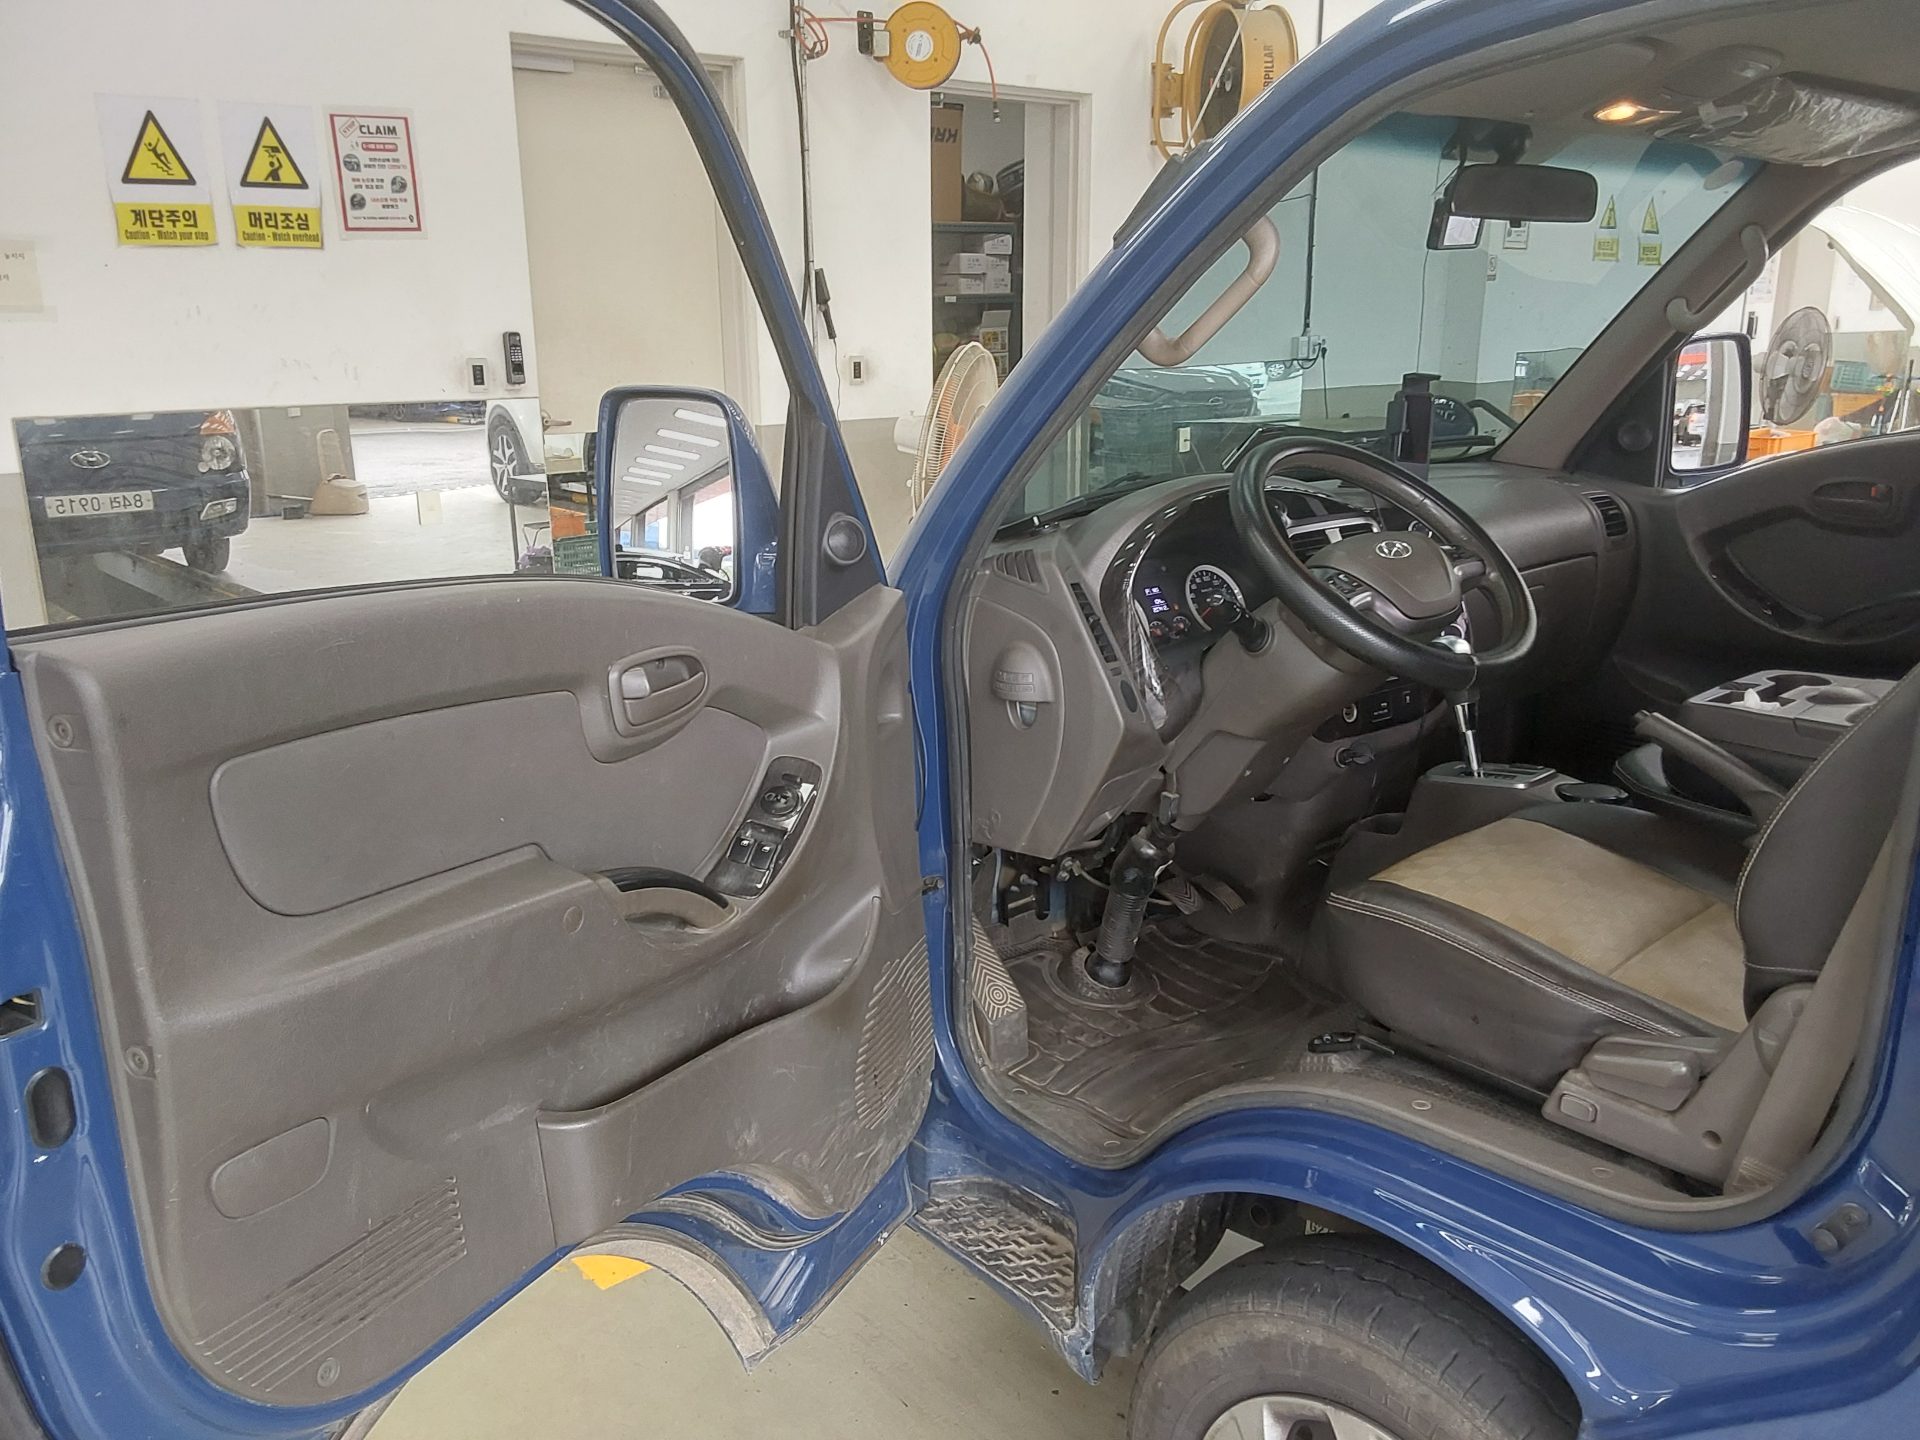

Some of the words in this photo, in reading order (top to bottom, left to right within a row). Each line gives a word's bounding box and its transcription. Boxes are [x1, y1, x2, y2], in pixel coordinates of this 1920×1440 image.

[359, 124, 398, 136] CLAIM
[130, 209, 198, 228] 계단주의
[248, 211, 310, 231] 머리조심
[125, 229, 150, 240] Caution
[157, 230, 177, 240] Watch
[179, 231, 193, 241] your
[242, 230, 266, 241] Caution
[272, 231, 291, 242] Watch
